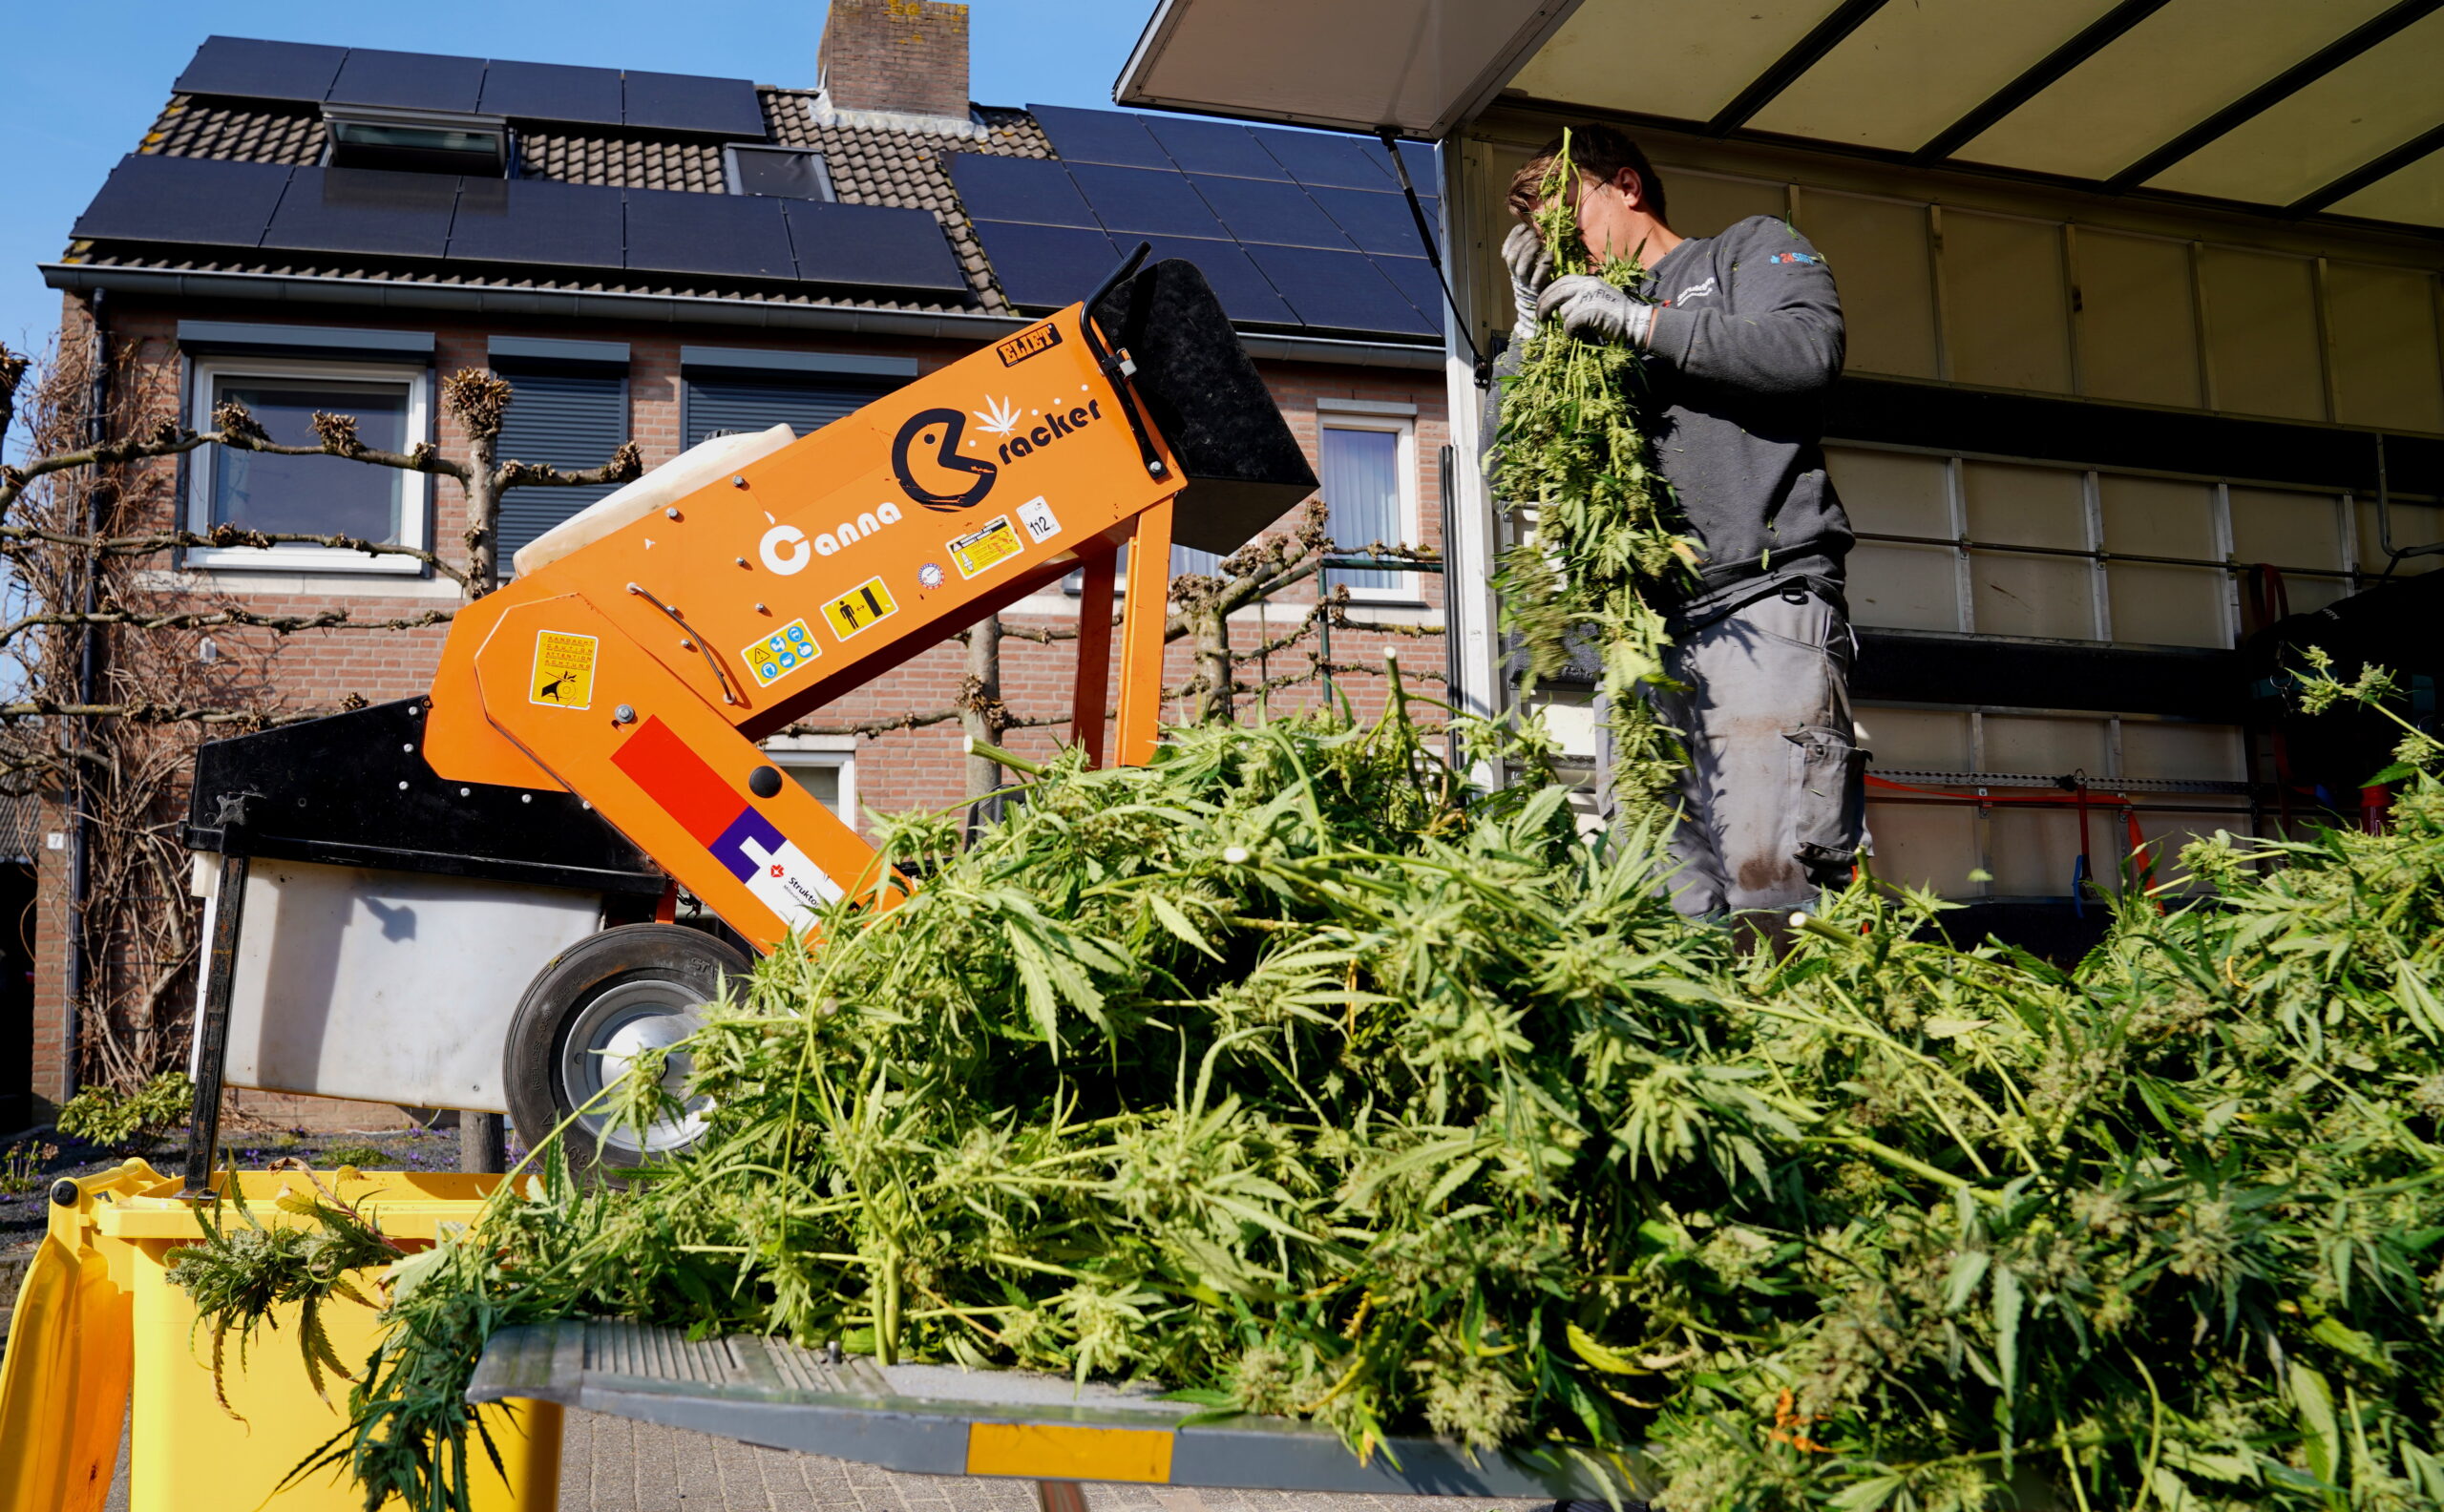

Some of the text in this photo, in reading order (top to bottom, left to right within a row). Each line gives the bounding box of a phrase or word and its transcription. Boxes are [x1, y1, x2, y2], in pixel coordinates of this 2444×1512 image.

[999, 326, 1054, 365] ELIET
[1030, 516, 1051, 536] 112
[759, 501, 903, 576] Canna
[545, 651, 592, 662] ATTENTION
[546, 643, 593, 654] CAUTION
